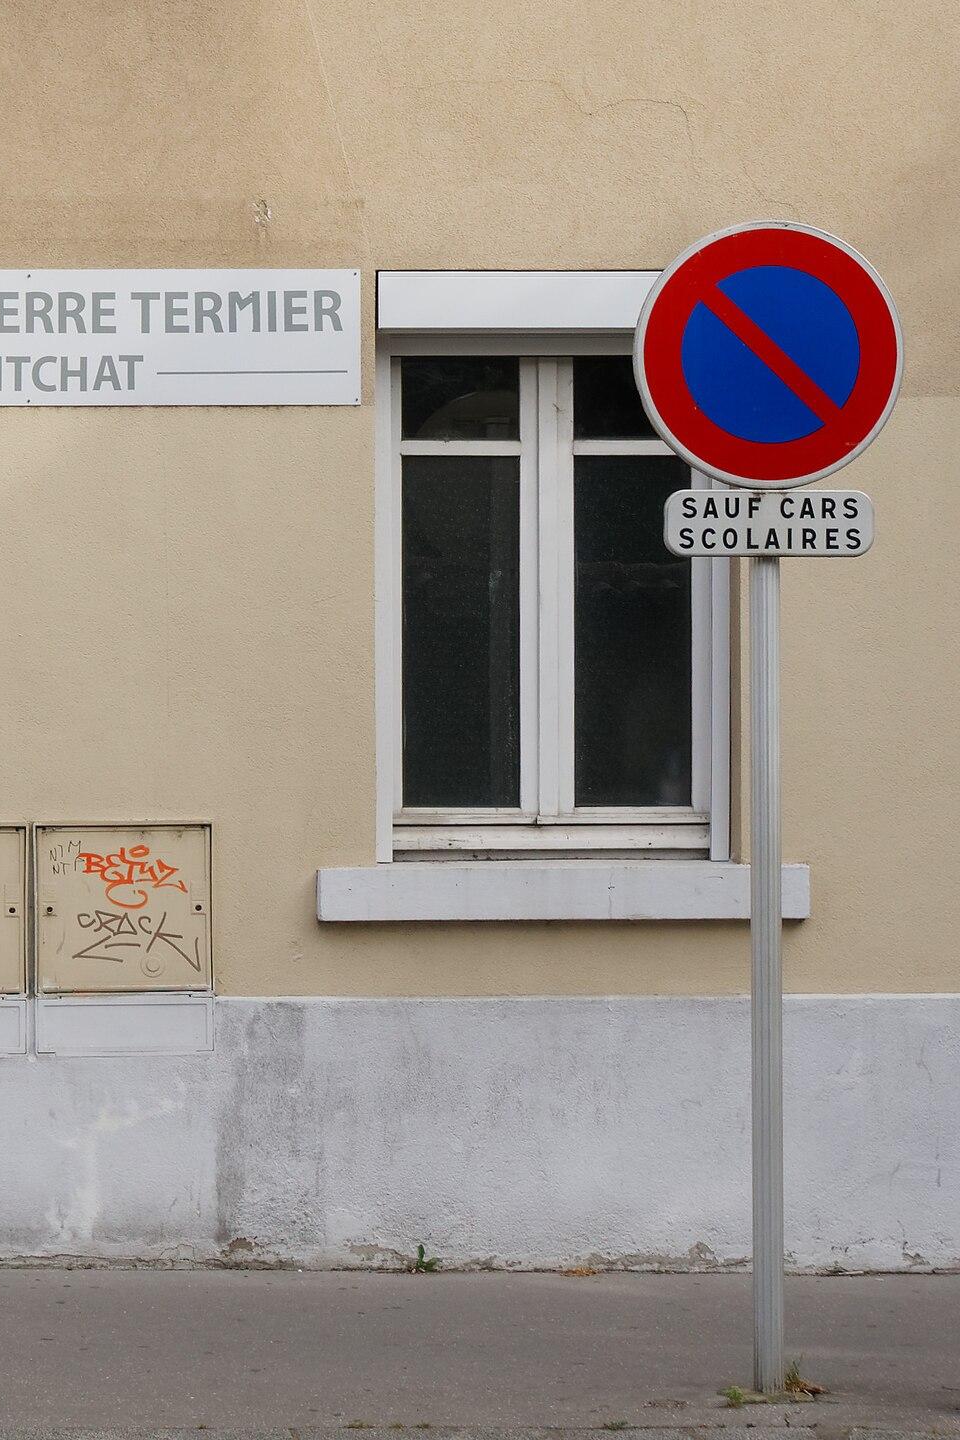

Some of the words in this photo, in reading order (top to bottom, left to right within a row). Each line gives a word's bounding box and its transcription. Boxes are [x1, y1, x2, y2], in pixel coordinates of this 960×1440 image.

[130, 289, 344, 333] TERMIER
[682, 496, 762, 519] SAUF
[779, 497, 859, 519] CARS
[678, 527, 862, 550] SCOLAIRES
